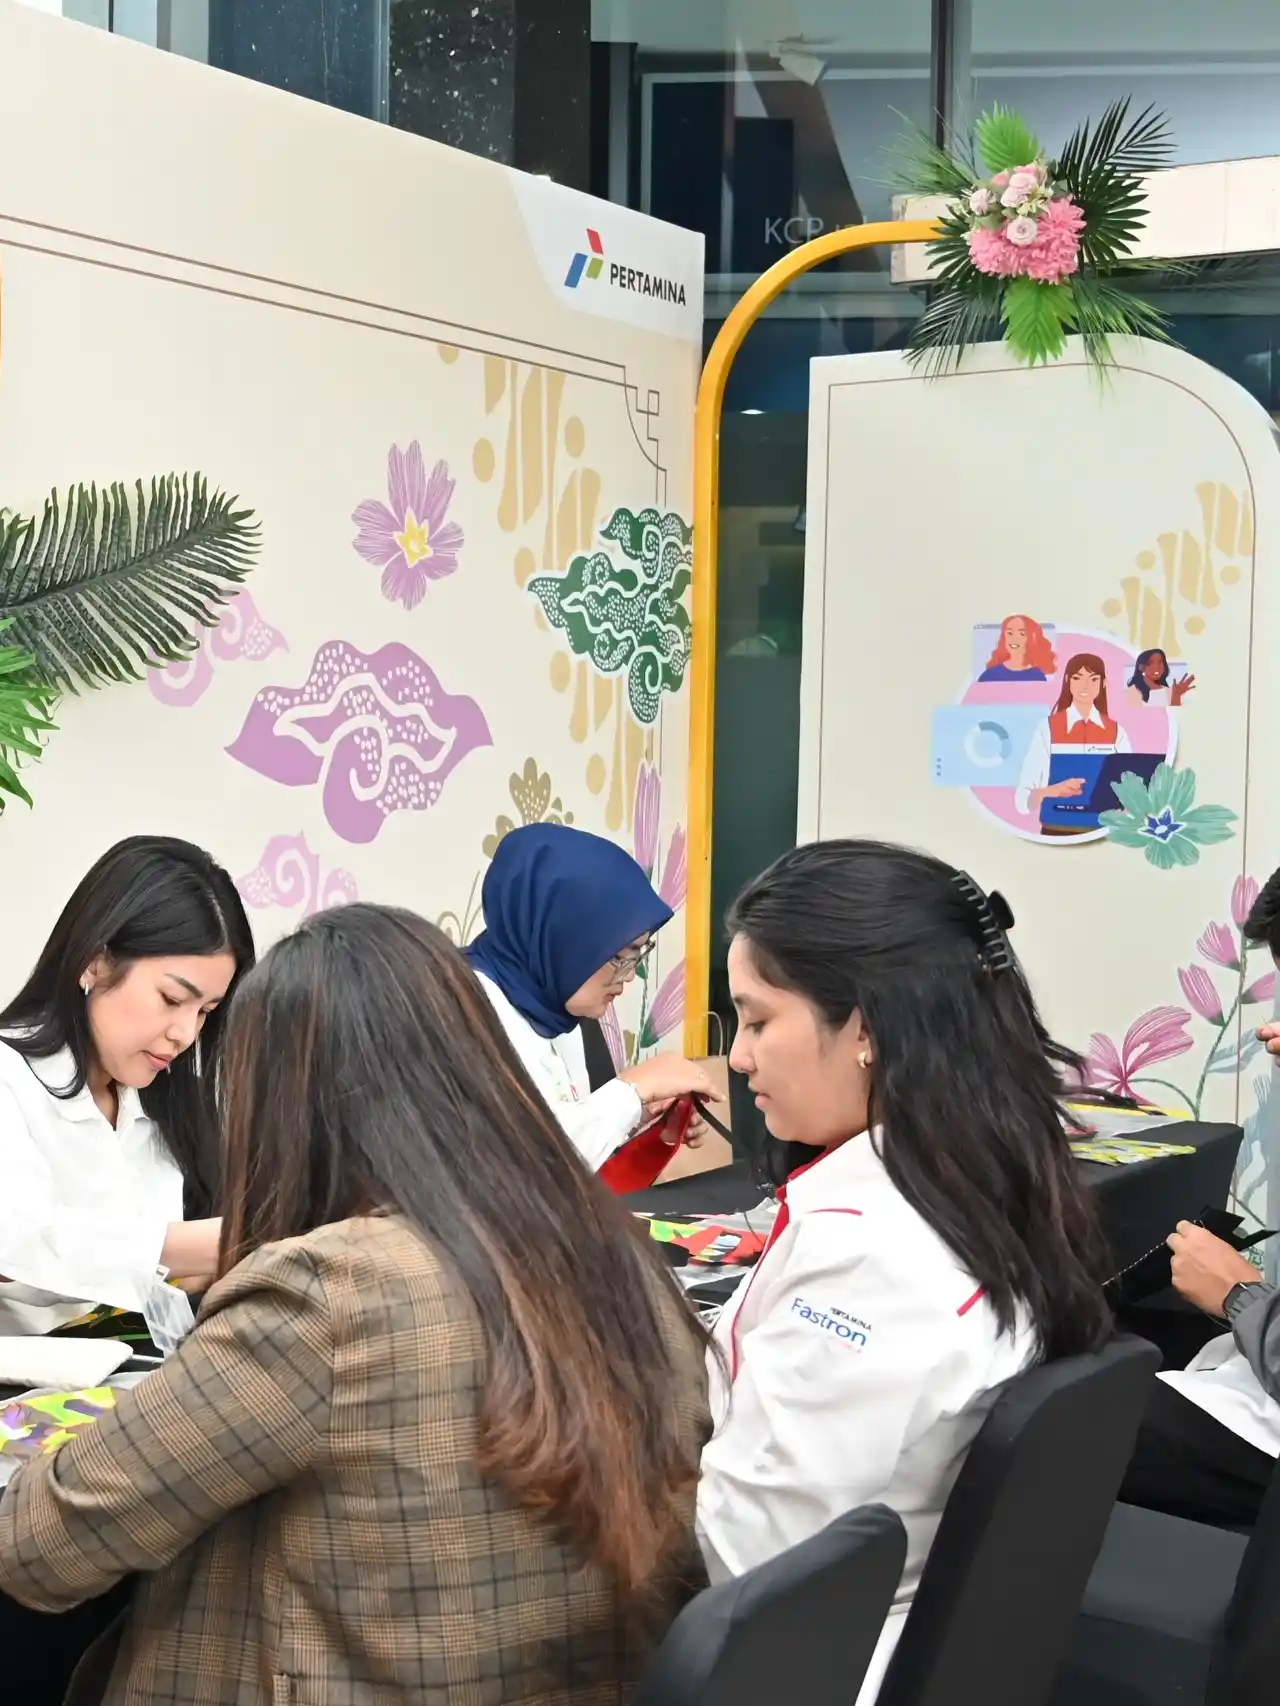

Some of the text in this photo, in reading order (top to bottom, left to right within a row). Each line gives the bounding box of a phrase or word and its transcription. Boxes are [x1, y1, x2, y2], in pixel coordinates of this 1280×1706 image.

[764, 217, 824, 244] KCP
[610, 263, 686, 306] PERTAMINA
[791, 1297, 867, 1346] Fastron
